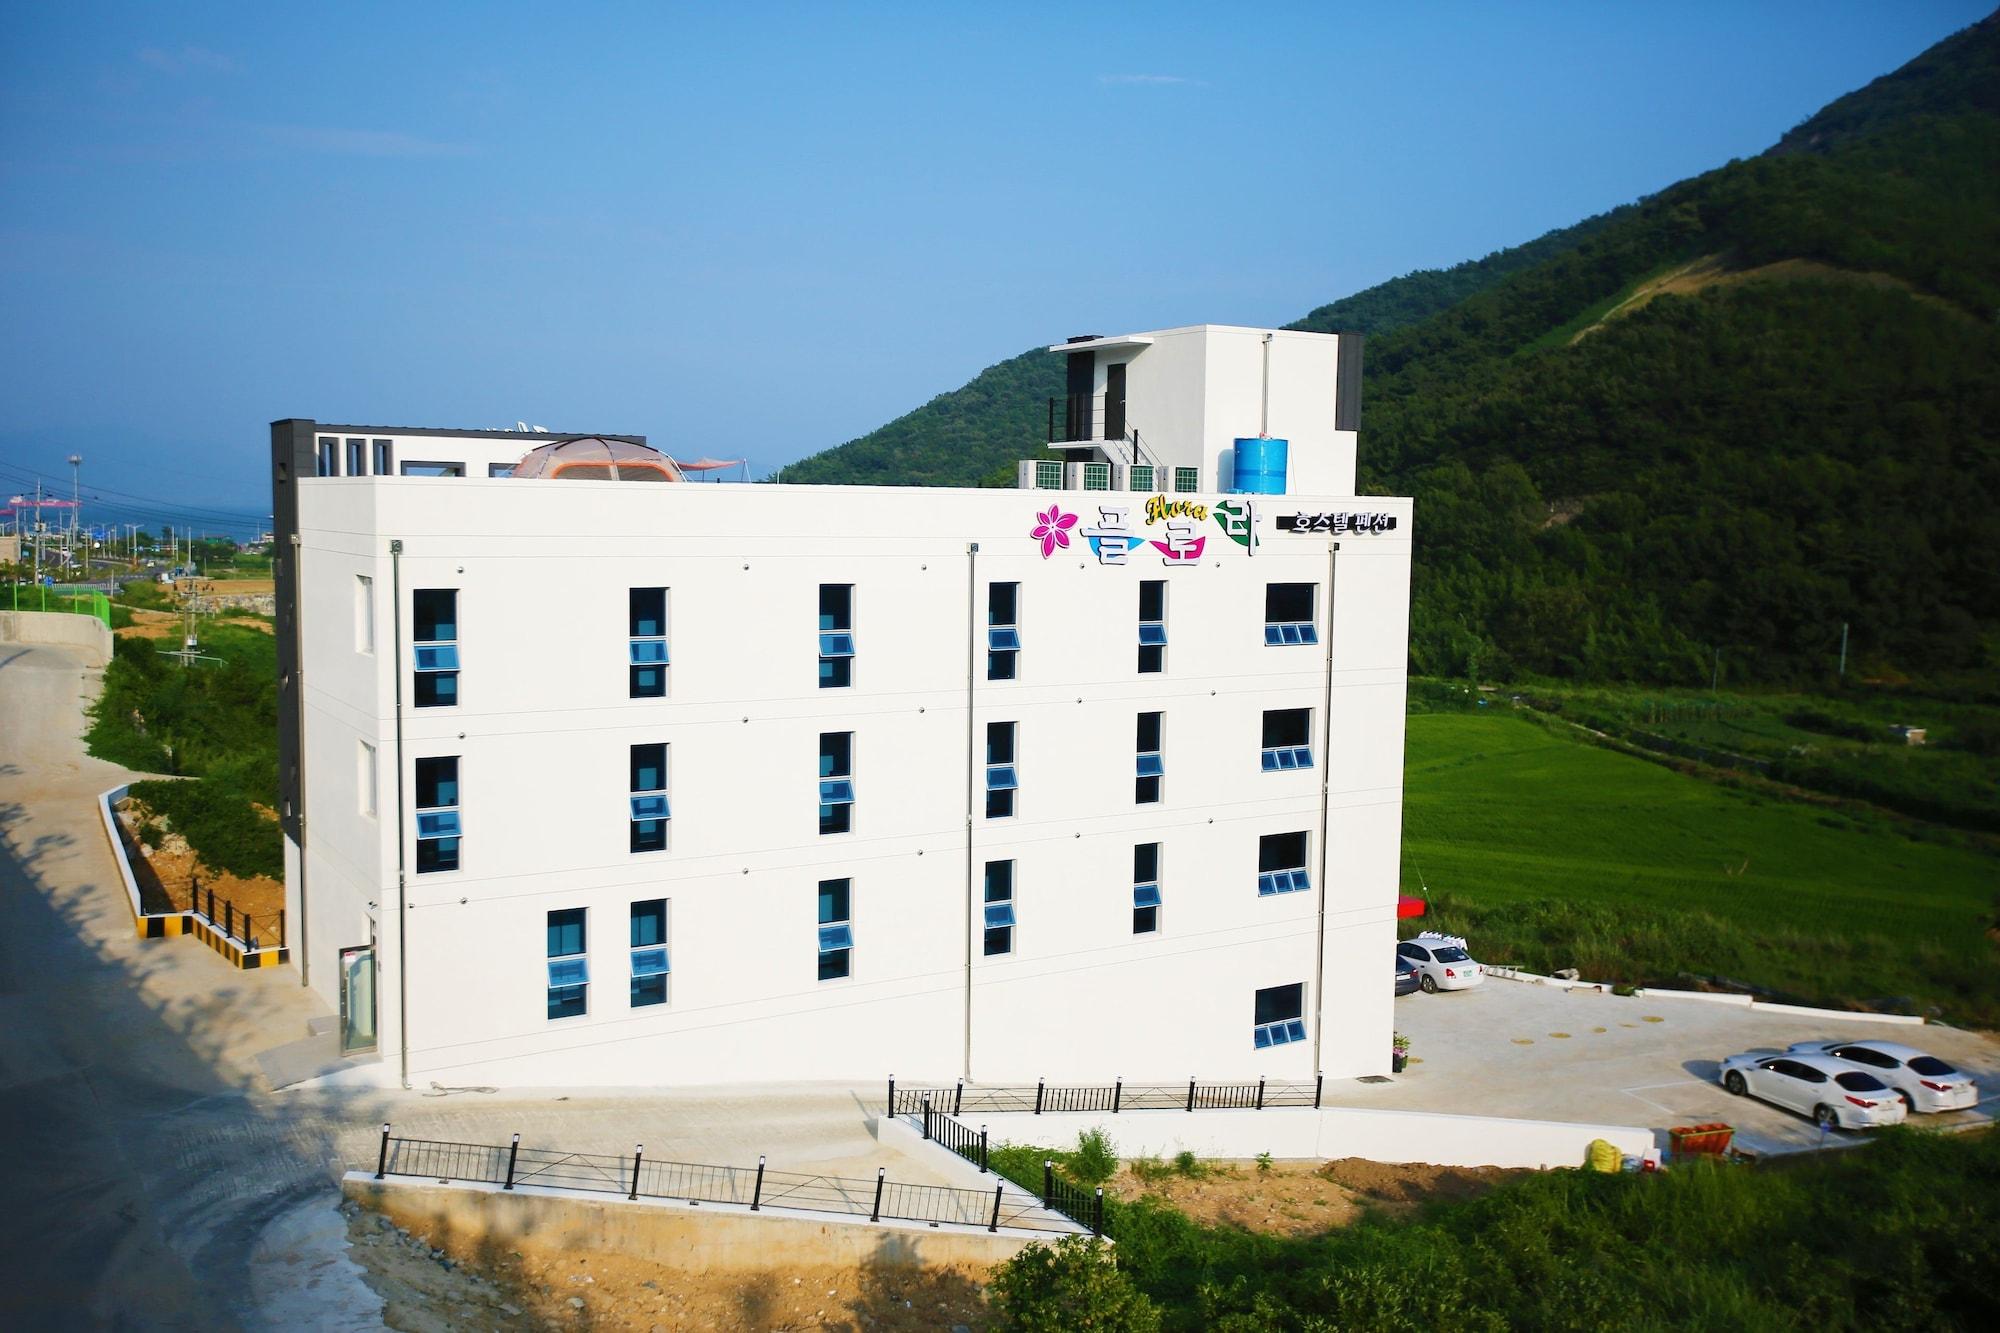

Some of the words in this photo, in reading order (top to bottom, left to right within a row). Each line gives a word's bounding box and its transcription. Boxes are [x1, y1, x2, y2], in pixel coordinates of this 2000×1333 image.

[1145, 494, 1209, 525] Flora
[1293, 511, 1350, 534] 호스텔
[1354, 512, 1390, 534] 펜션
[1080, 500, 1262, 566] 플로라
